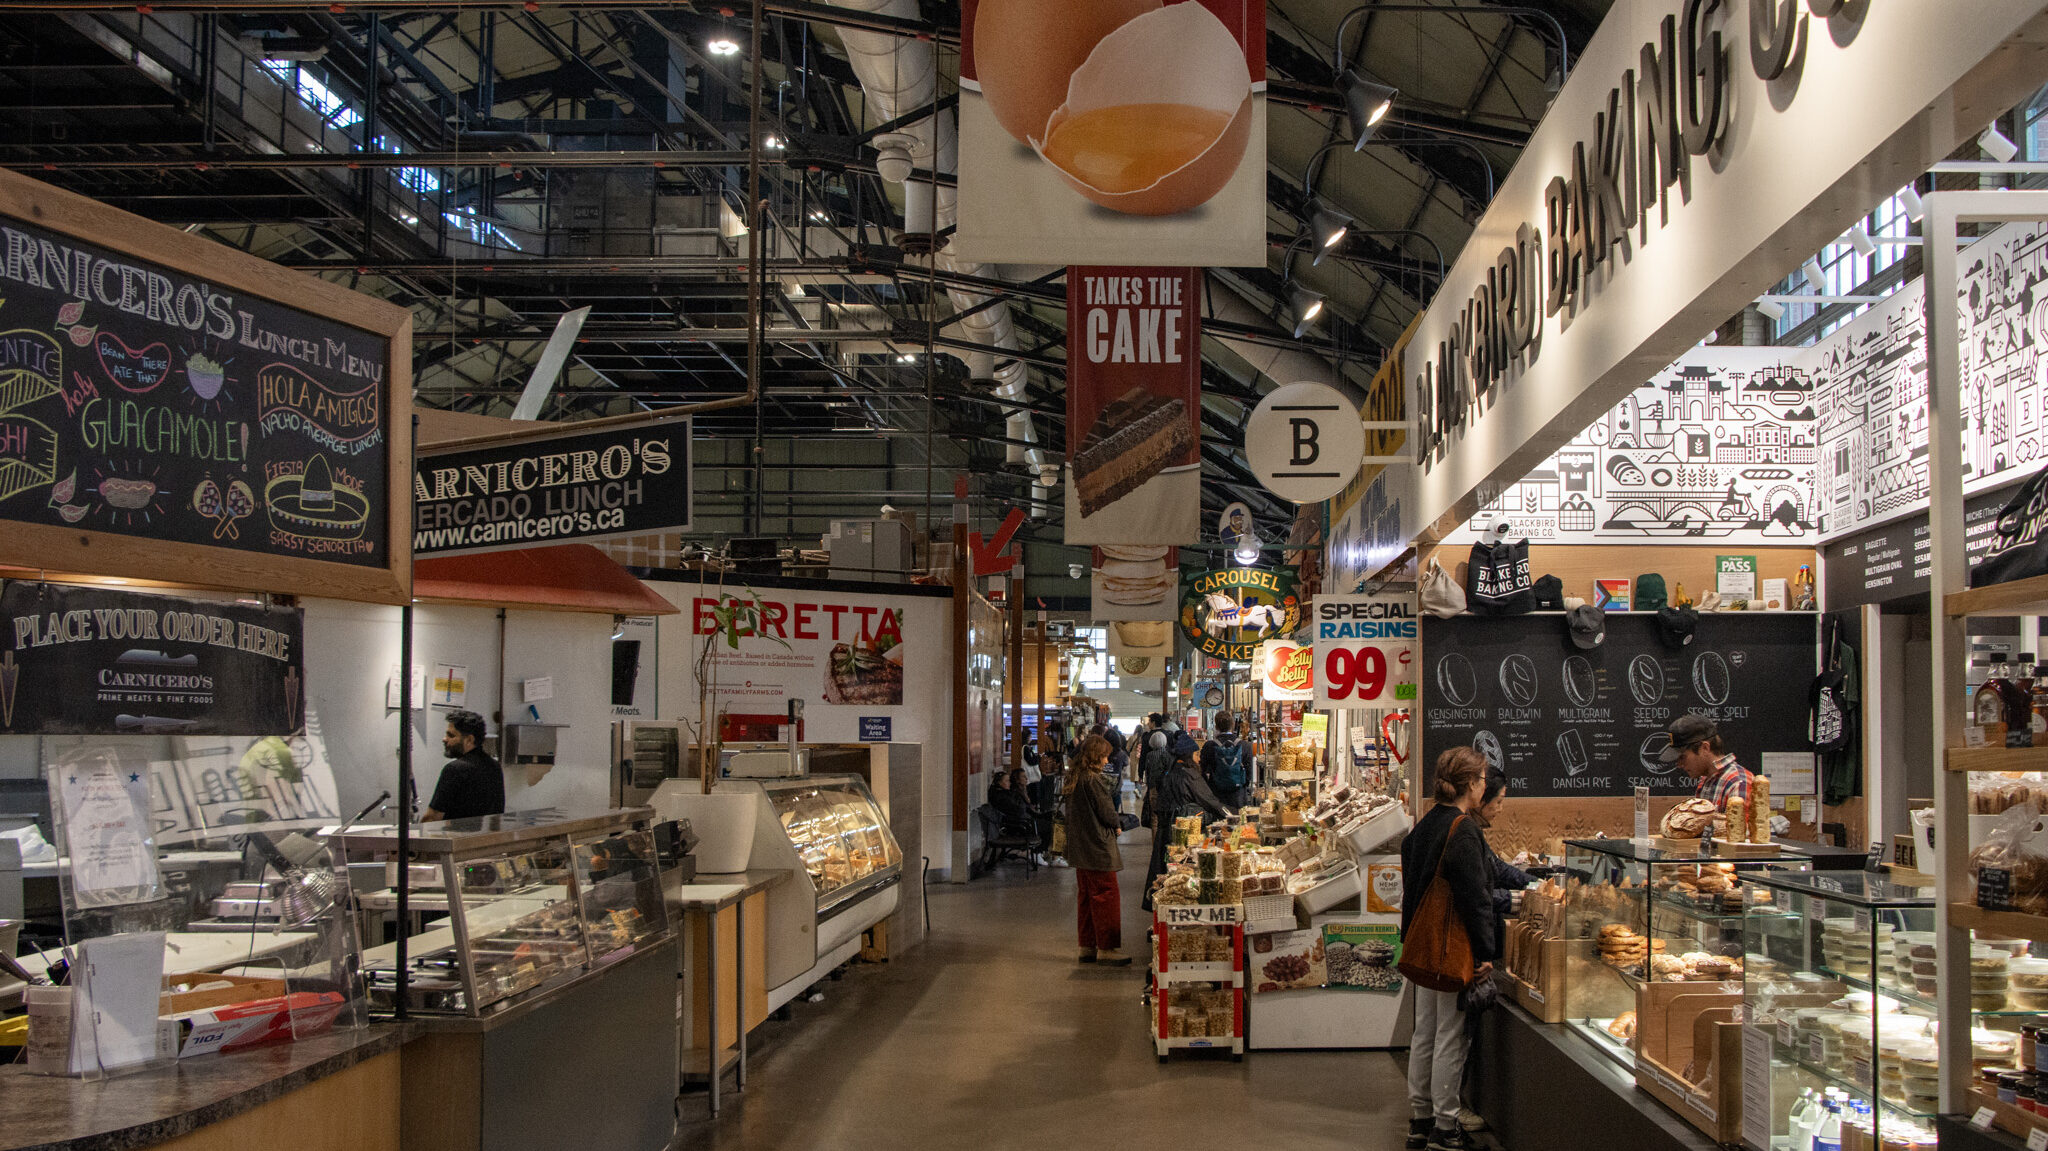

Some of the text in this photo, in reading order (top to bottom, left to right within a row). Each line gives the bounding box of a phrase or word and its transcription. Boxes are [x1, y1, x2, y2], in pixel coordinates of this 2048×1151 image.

[1417, 222, 1536, 465] BLACKBIRD
[1545, 0, 1722, 318] BAKING
[1084, 276, 1182, 305] TAKES THE
[1086, 308, 1182, 364] CAKE
[238, 310, 320, 364] LUNCH
[326, 338, 383, 382] MENU
[141, 356, 168, 371] THERE
[113, 365, 158, 384] ATE THAT
[263, 374, 376, 429] HOLA AMIGOS
[2023, 400, 2030, 421] B
[82, 397, 249, 473] GUACAMOLE!
[260, 412, 383, 456] NACHO AVERAGE LUNCH!
[1289, 417, 1320, 466] B
[264, 460, 304, 482] FIESTA
[335, 466, 365, 494] MODE
[416, 479, 643, 531] ERCADO LUNCH
[414, 507, 625, 549] www.carnicero's.ca
[1508, 519, 1556, 537] BLACKBIRD BAKING CO.
[1966, 520, 1998, 537] DANISH RY
[269, 531, 305, 549] SASSY
[1865, 537, 1887, 551] BAGUETTE
[1721, 560, 1751, 572] PASS
[1865, 563, 1891, 577] MULTIGRAIN
[1194, 569, 1280, 594] CAROUSEL
[1476, 580, 1514, 595] BAKNG
[1865, 576, 1893, 589] KENSINGTON
[692, 597, 903, 643] BERETTA
[1319, 603, 1417, 621] SPECIAL
[13, 608, 291, 662] PLACE YOUR ORDER HERE
[1319, 621, 1417, 639] RAISINS
[772, 653, 793, 661] Canada
[1202, 637, 1262, 660] BAKE
[1286, 646, 1313, 671] Jelly
[98, 668, 215, 690] CARNICERO'S
[1276, 666, 1308, 690] Belly
[1325, 646, 1387, 701] 99
[97, 693, 214, 704] PRIME MEATS & FINE FOODS
[705, 688, 783, 696] ERETTAFAMILYFARMS.COM
[615, 706, 641, 716] Meats.
[1428, 708, 1486, 720] KENSINGTON
[1498, 708, 1541, 719] BALDWIN
[1558, 708, 1611, 719] MULTIGRAIN
[1633, 708, 1670, 719] SEEDED
[1687, 706, 1751, 718] SESAME SPELT
[1511, 777, 1528, 789] RYE
[1552, 777, 1611, 789] DANISH RYE
[1627, 776, 1675, 788] SEASONAL
[1168, 906, 1236, 923] TRY ME
[192, 1032, 224, 1045] FOIL
